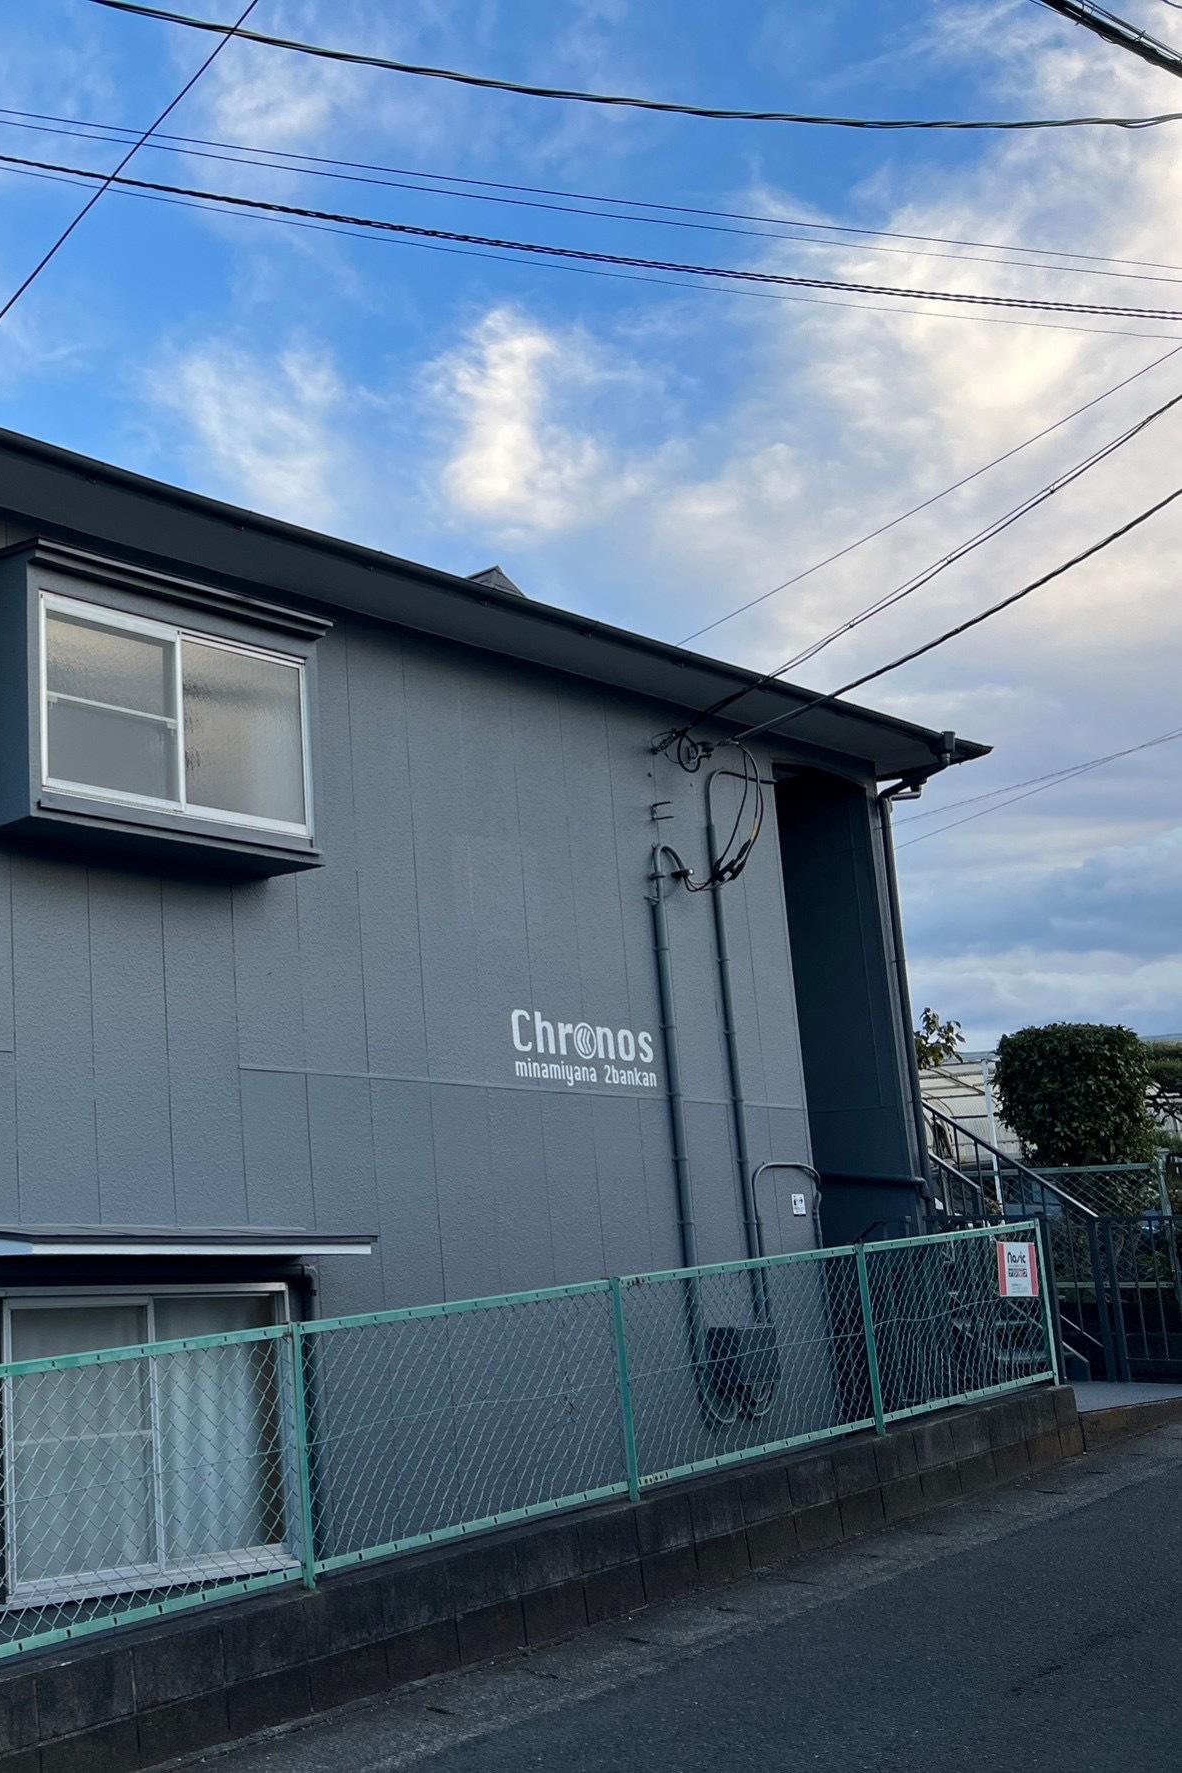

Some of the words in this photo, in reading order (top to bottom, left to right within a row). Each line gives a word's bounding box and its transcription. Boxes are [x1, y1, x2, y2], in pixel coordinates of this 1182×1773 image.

[511, 1009, 654, 1063] Chronos
[515, 1058, 598, 1086] minamiyana
[604, 1065, 658, 1088] 2bankan
